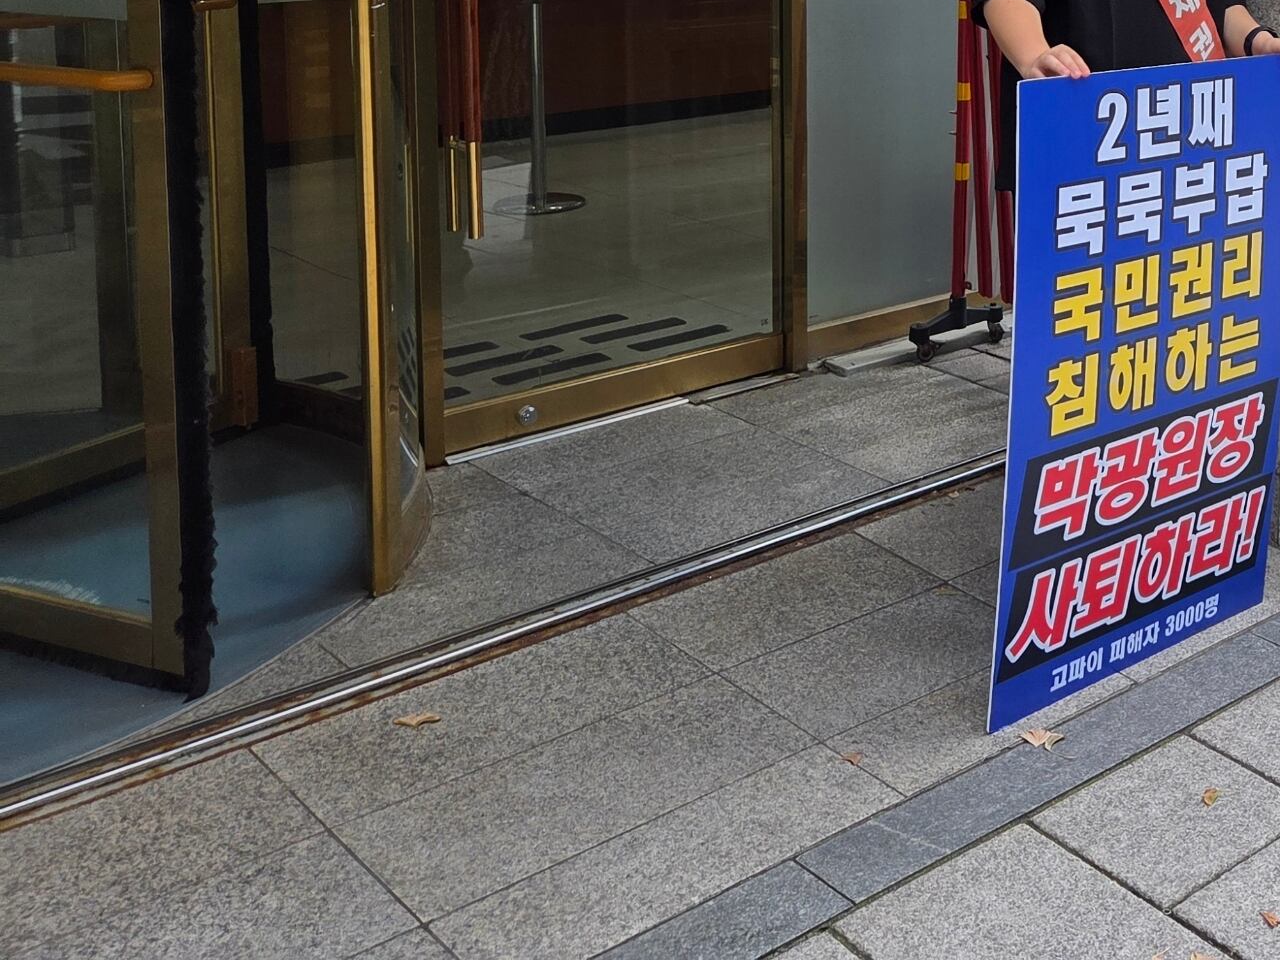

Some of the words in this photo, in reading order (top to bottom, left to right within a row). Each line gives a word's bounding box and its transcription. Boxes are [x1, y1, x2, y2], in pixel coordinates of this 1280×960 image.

[1095, 76, 1235, 164] 2년째
[1055, 152, 1268, 256] 묵묵부답
[1053, 230, 1264, 342] 국민권리
[1045, 315, 1260, 437] 침해하는
[1034, 391, 1265, 540] 박광원장
[1005, 486, 1266, 663] 사퇴하라!
[1050, 647, 1104, 692] 고파이
[1109, 621, 1160, 663] 피해자
[1165, 593, 1219, 637] 3000명
